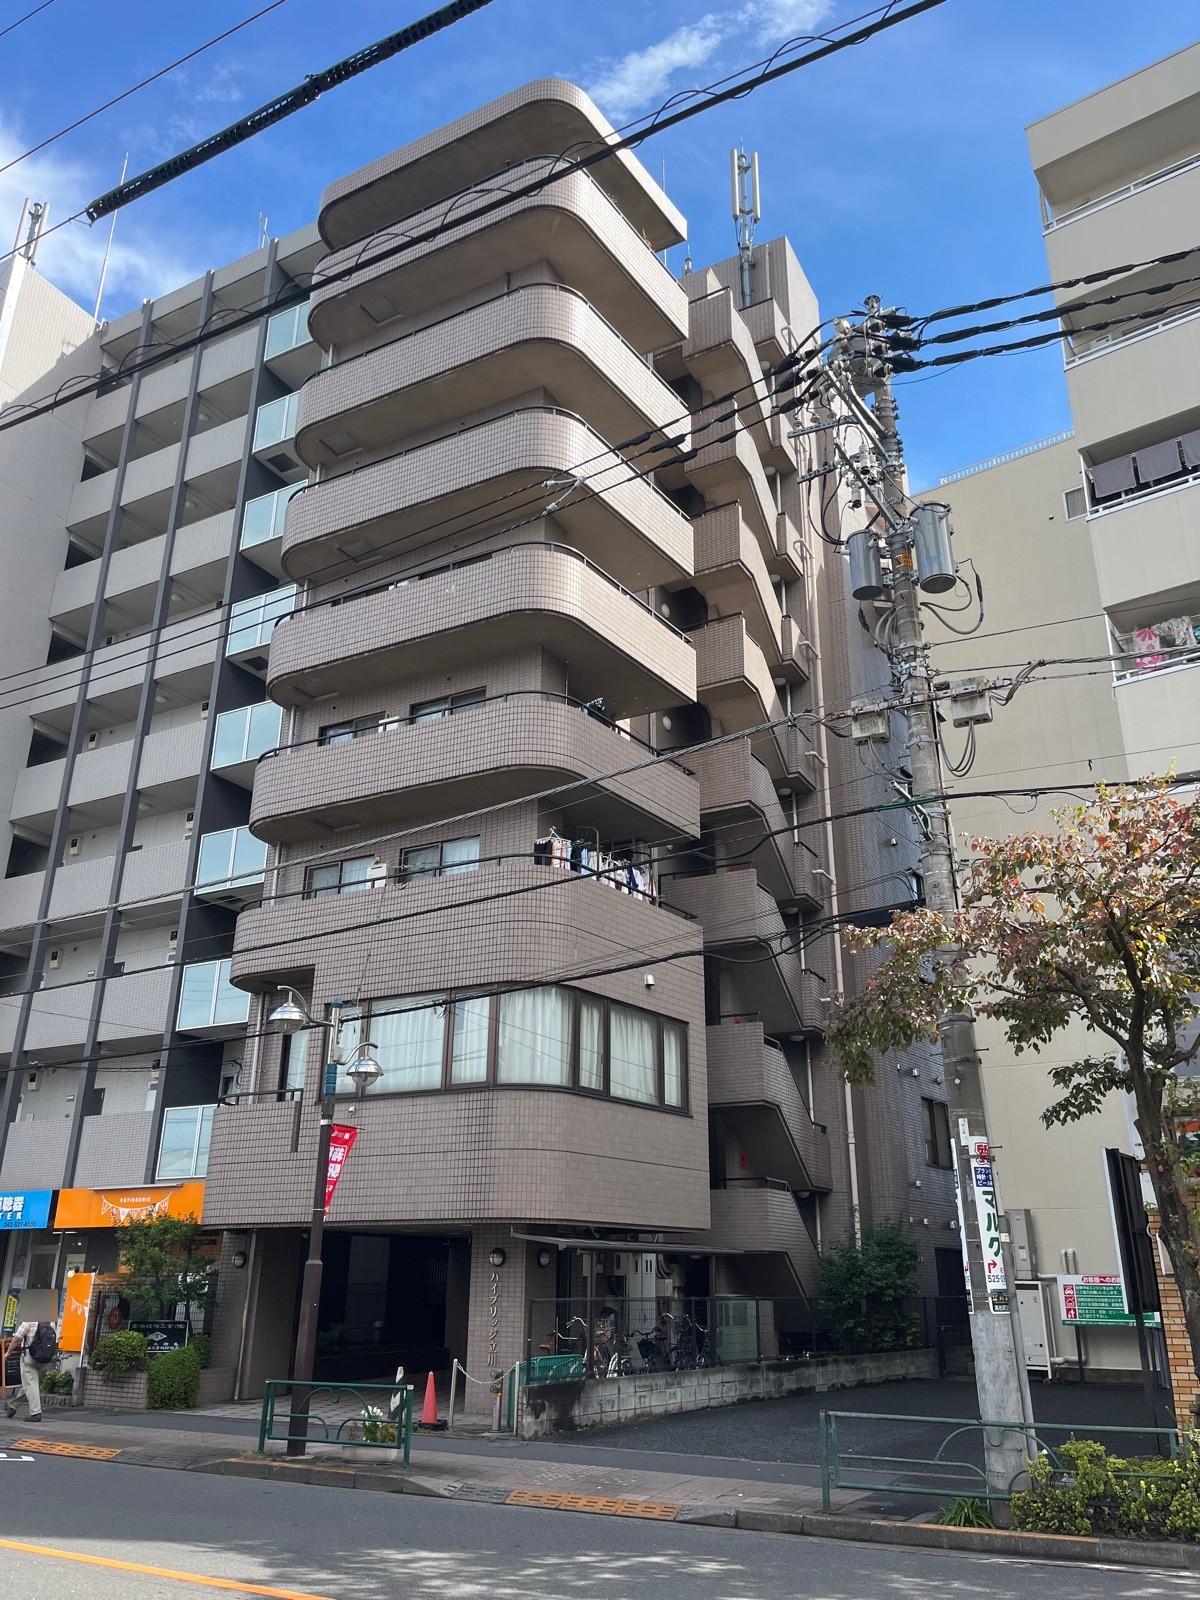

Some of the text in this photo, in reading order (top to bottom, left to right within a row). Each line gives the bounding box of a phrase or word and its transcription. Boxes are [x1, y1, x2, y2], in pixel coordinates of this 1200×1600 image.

[487, 1272, 499, 1367] ハイブリッジ立川
